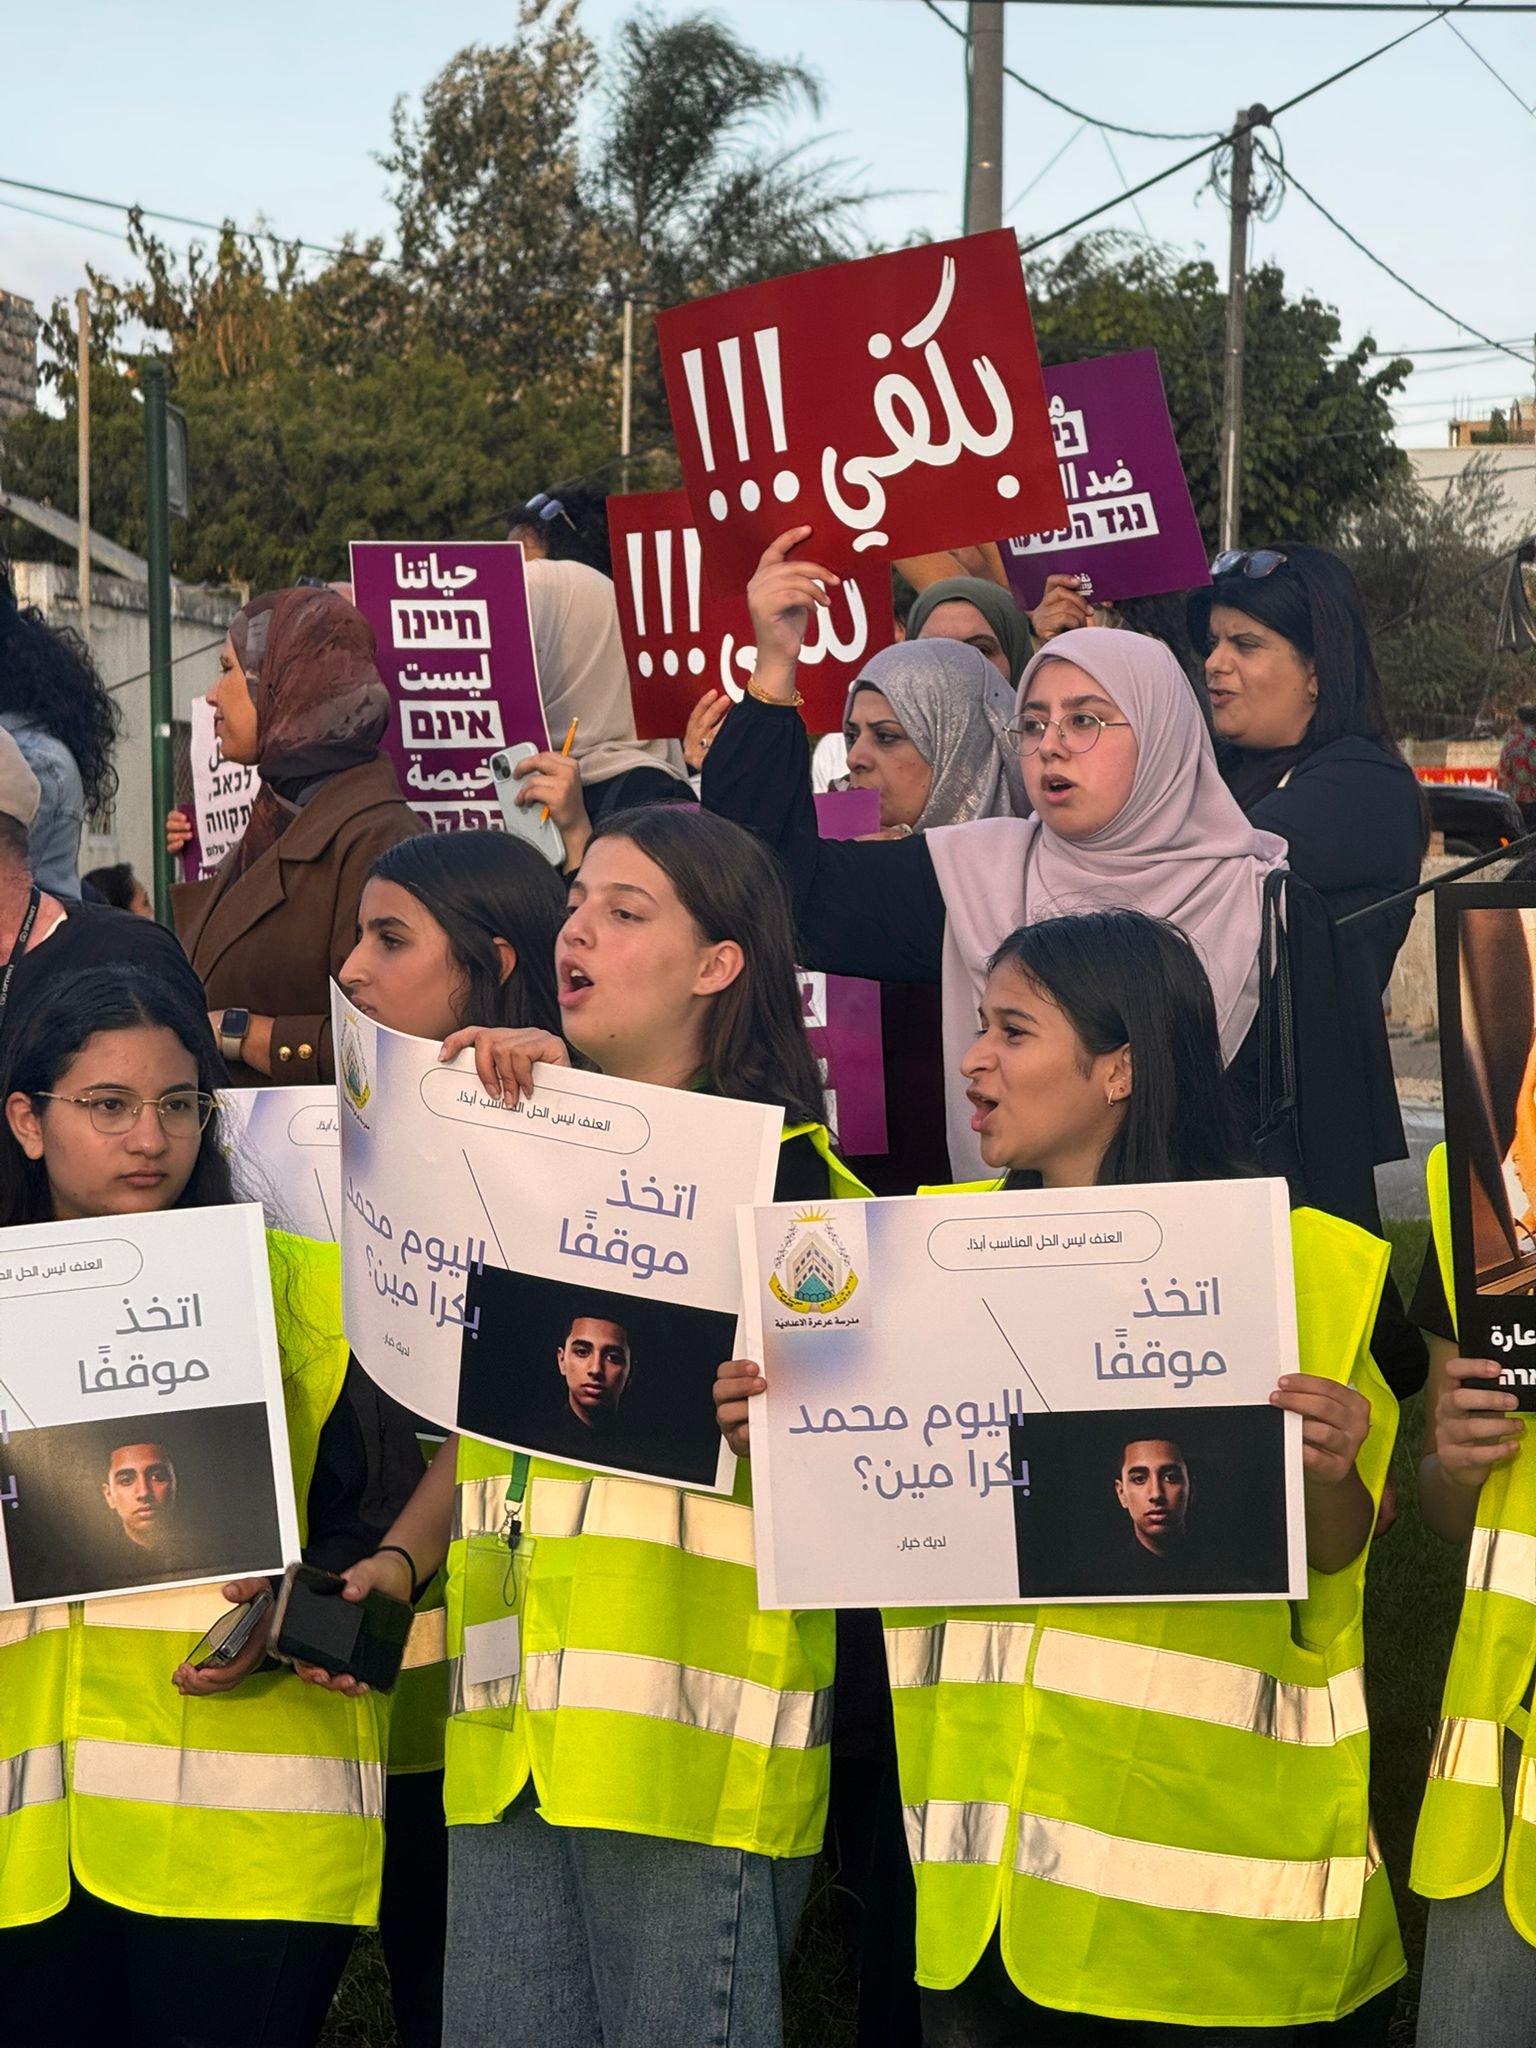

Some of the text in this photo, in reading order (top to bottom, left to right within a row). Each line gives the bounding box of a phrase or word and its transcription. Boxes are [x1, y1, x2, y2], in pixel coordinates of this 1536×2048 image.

[1086, 459, 1133, 497] ضد
[1097, 503, 1148, 534] נגד
[395, 552, 477, 597] حياتنا
[398, 610, 482, 639] חיינו
[399, 654, 492, 697] ليست
[410, 710, 496, 739] אינם
[406, 754, 495, 797] خيصة
[205, 798, 254, 834] תקווה
[526, 1105, 550, 1119] الحل
[552, 1113, 576, 1126] ليس
[577, 1116, 611, 1132] العنف
[606, 1169, 697, 1220] اتخذ
[346, 1175, 486, 1279] اليوم محمد
[559, 1210, 689, 1280] موقفًا
[989, 1235, 1033, 1251] المناسب
[1036, 1234, 1059, 1251] الحل
[1062, 1233, 1087, 1249] ليس
[1089, 1231, 1123, 1245] العنف
[16, 1266, 39, 1281] الحل
[42, 1262, 66, 1278] ليس
[69, 1258, 103, 1272] العنف
[366, 1244, 481, 1341] بكرا مين؟
[1133, 1277, 1220, 1318] اتخذ
[115, 1293, 202, 1335] اتخذ
[79, 1344, 210, 1396] موقفًا
[1095, 1328, 1227, 1388] موقفًا
[788, 1388, 1025, 1447] اليوم محمد
[853, 1449, 1031, 1500] بكرا مين؟
[896, 1535, 947, 1552] لديك خيار.
